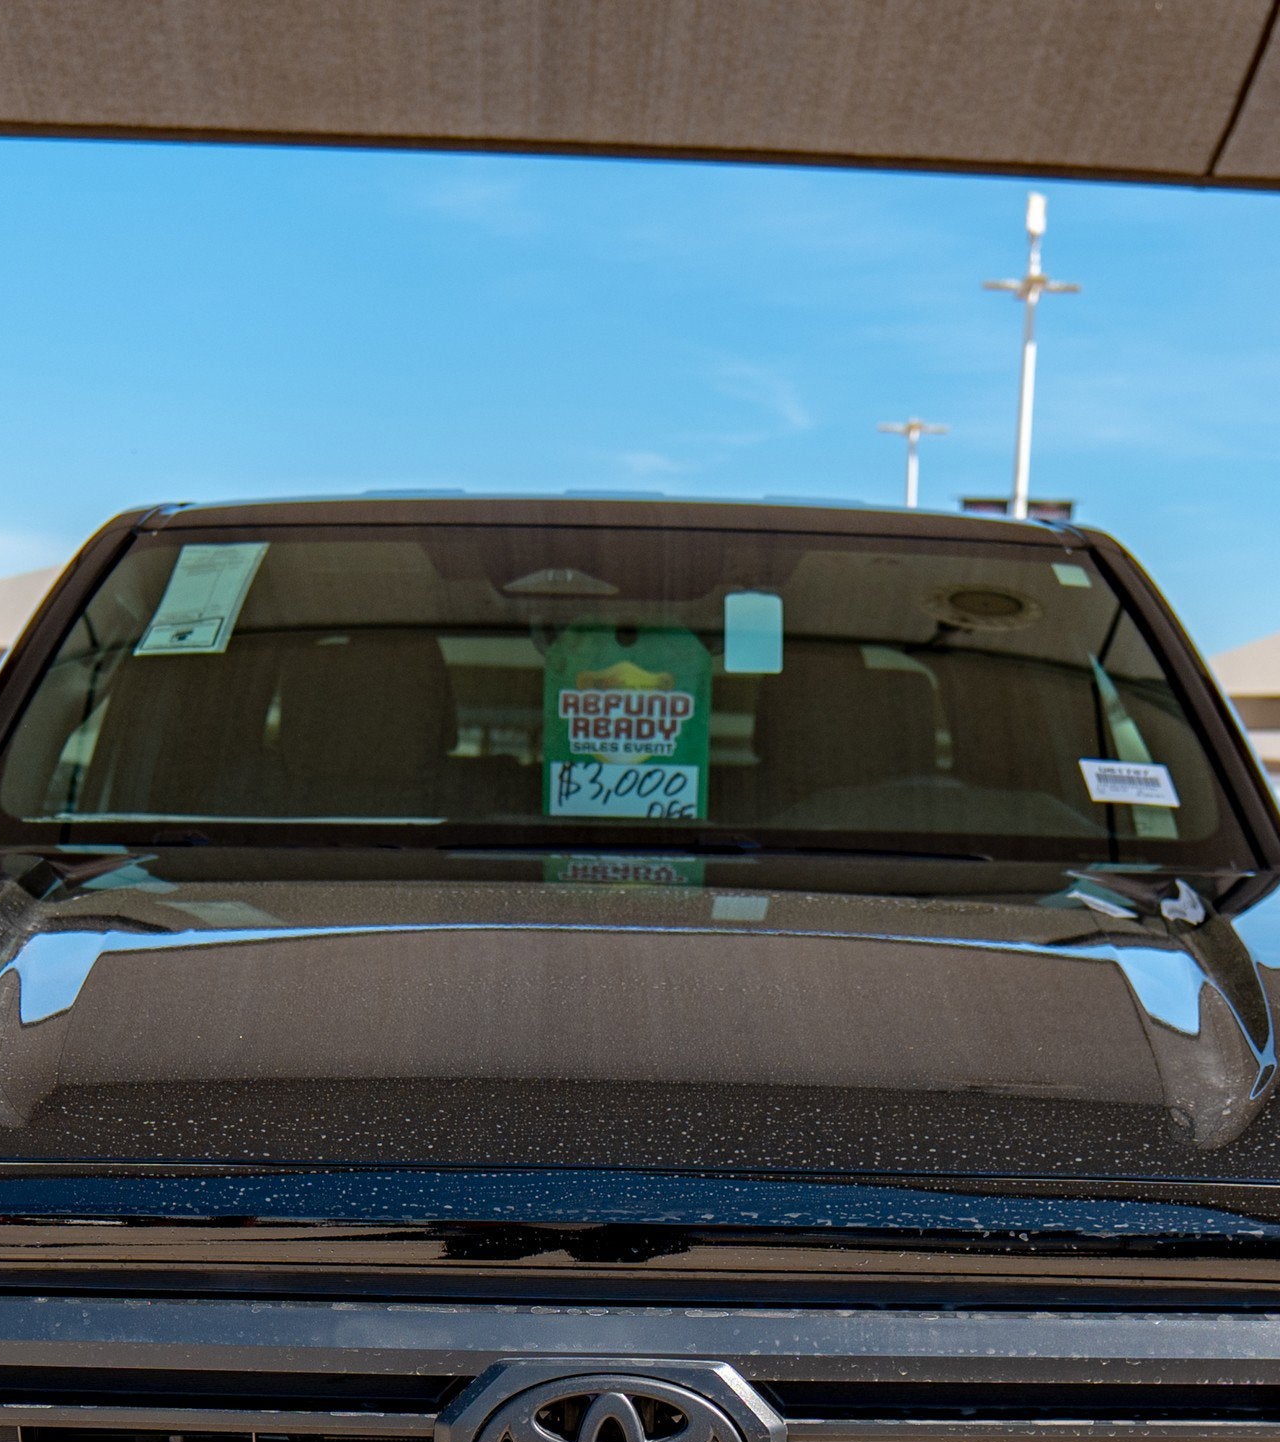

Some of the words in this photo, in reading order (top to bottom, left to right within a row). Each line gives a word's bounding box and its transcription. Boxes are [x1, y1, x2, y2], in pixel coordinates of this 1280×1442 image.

[561, 692, 691, 717] REFUND
[572, 717, 679, 740] READY
[572, 742, 618, 753] SALES
[623, 742, 674, 755] EVENT
[558, 760, 688, 807] $3,000
